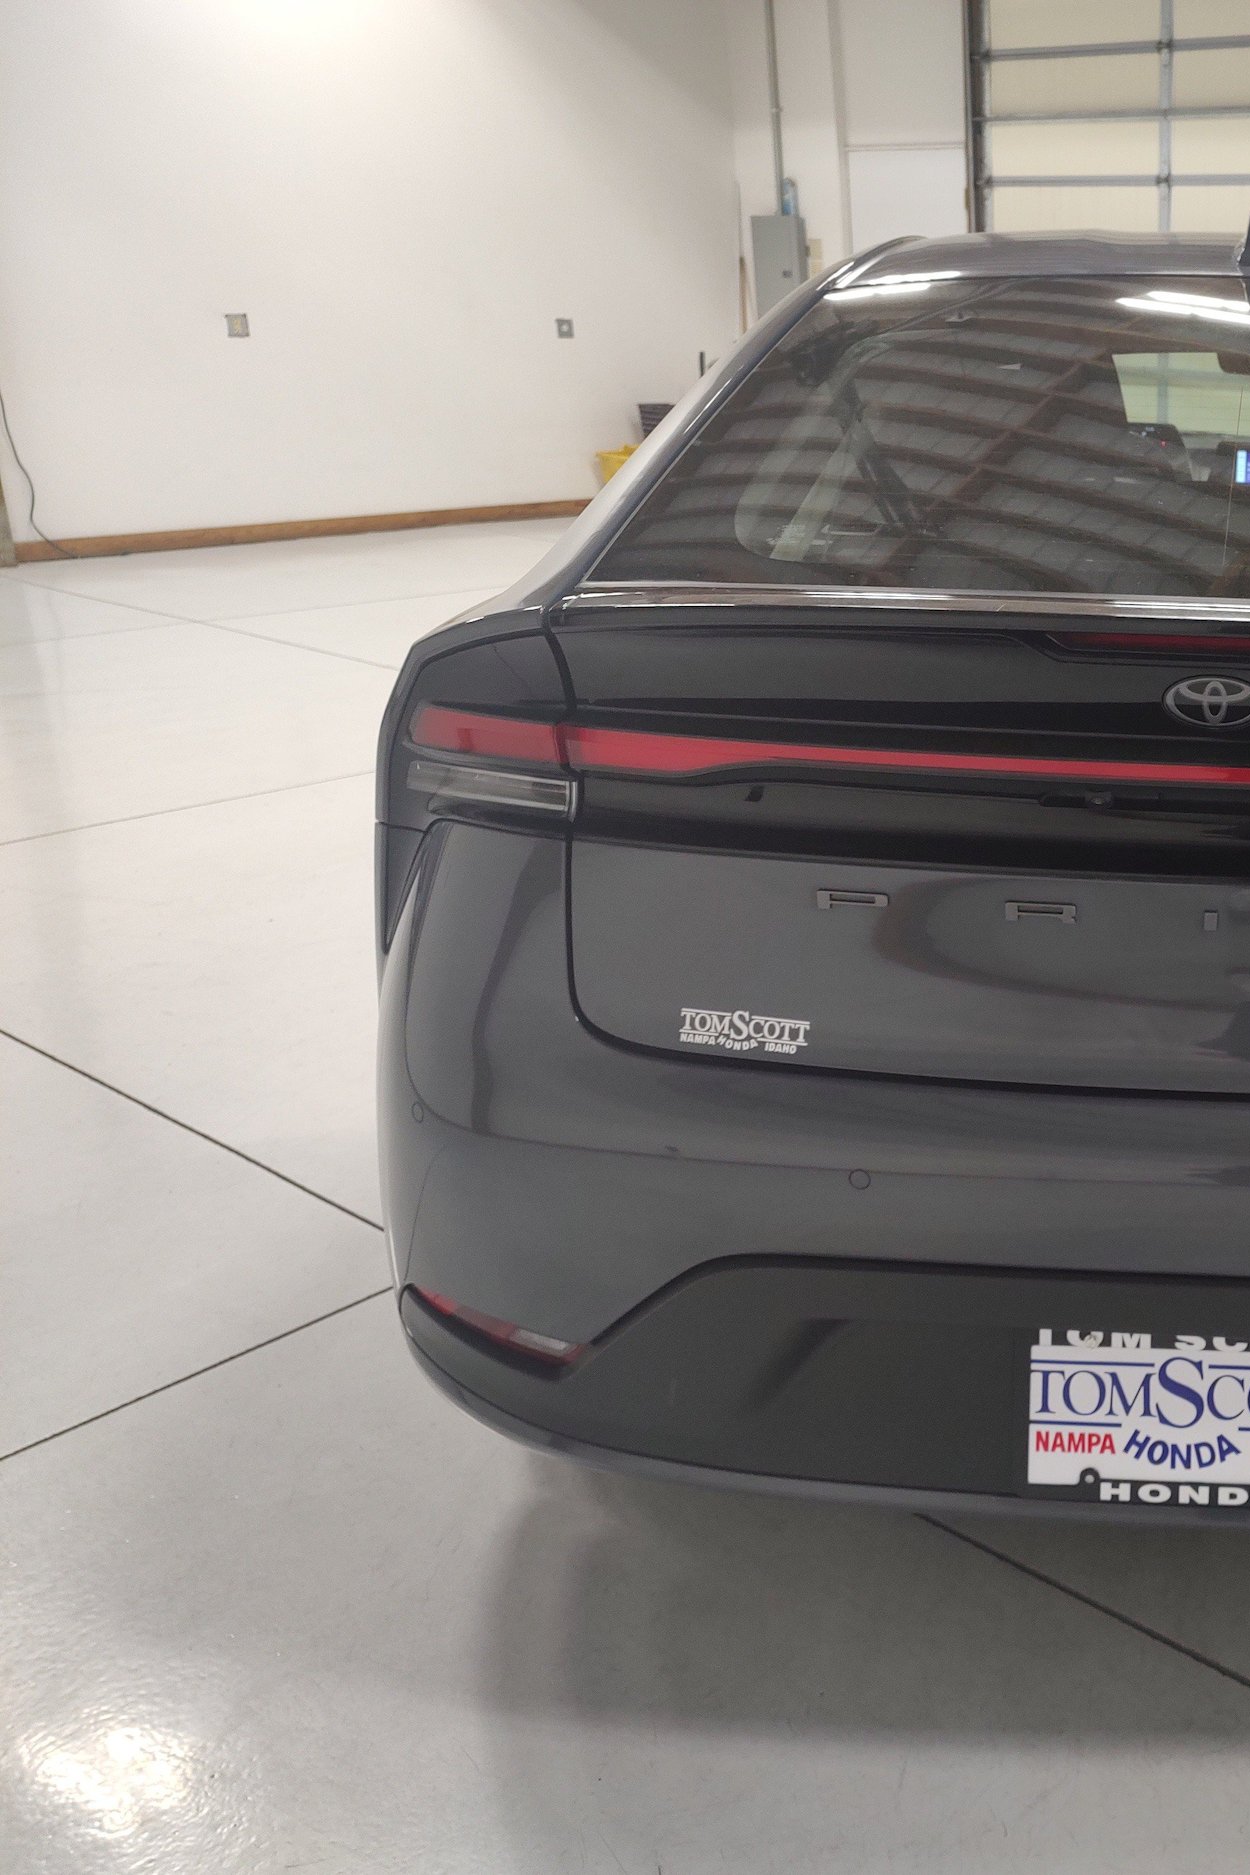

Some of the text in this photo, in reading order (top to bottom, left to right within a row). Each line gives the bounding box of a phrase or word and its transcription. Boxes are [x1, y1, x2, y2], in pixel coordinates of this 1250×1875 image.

[680, 1033, 797, 1054] NAMPA HONDA IDAHO
[1035, 1430, 1116, 1455] NAMPA
[1123, 1429, 1241, 1470] HONDA
